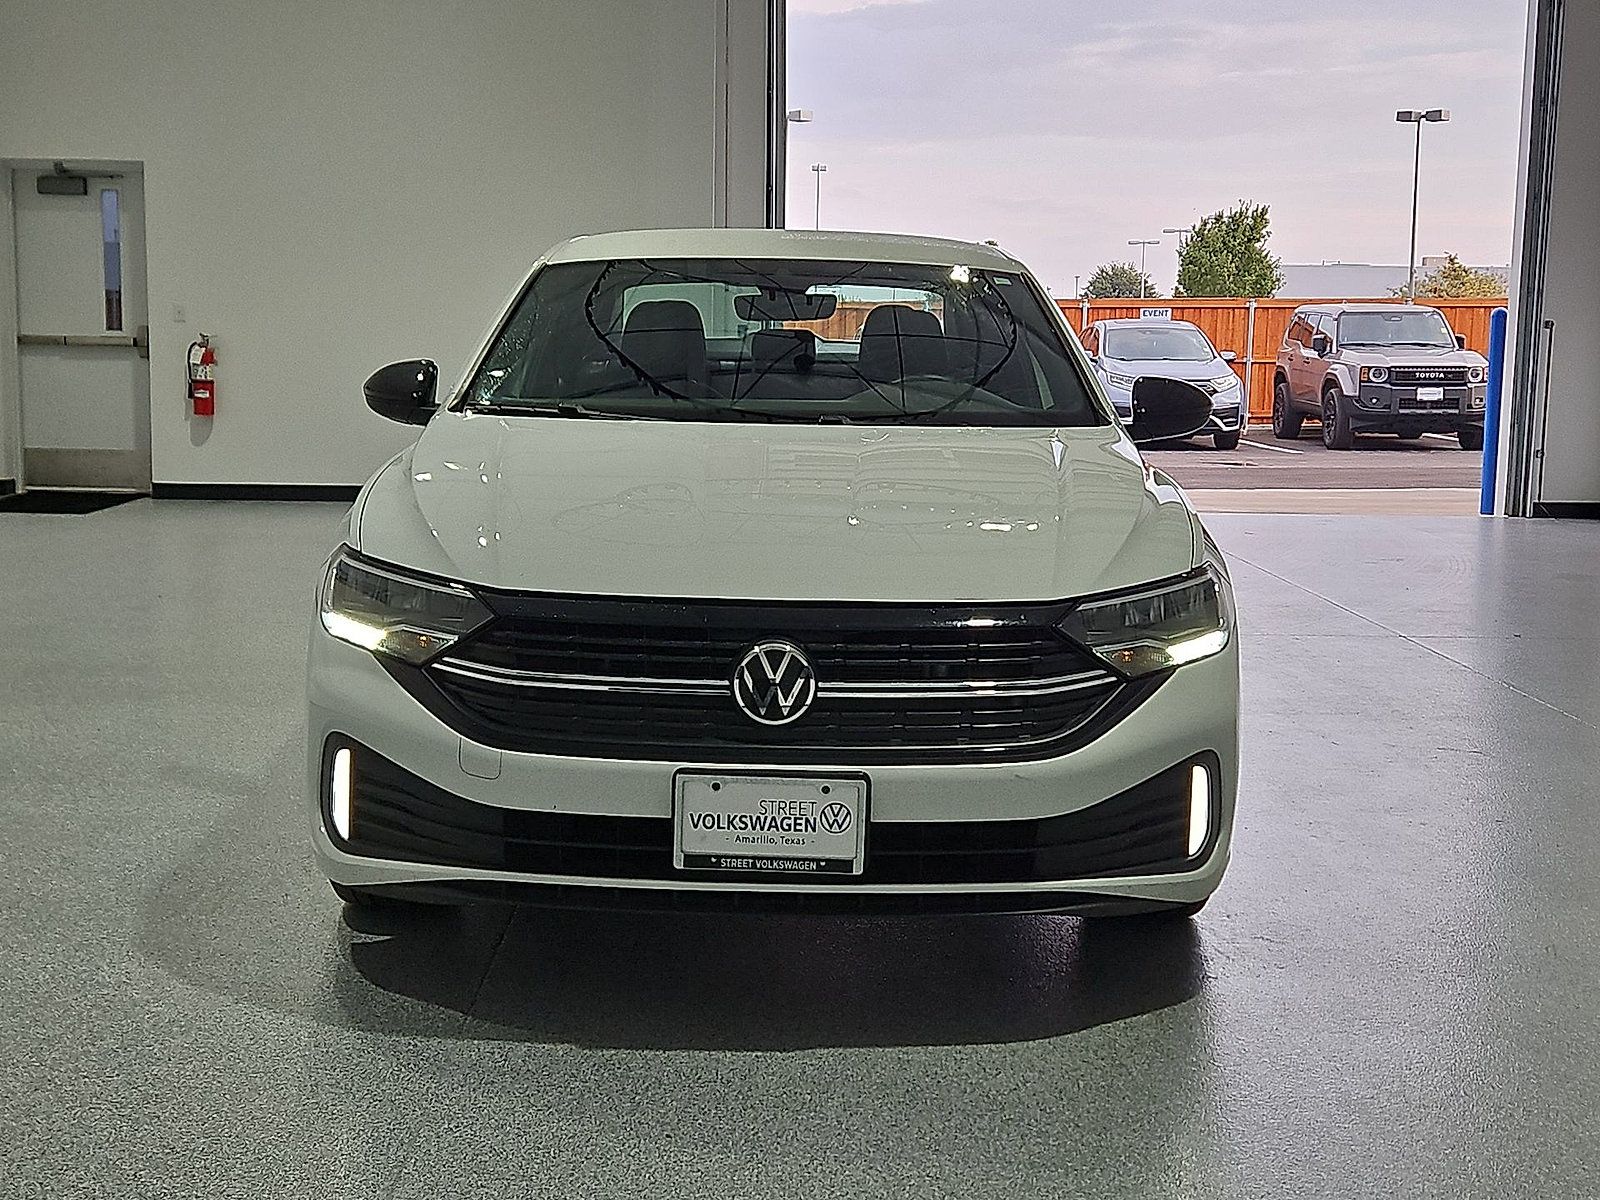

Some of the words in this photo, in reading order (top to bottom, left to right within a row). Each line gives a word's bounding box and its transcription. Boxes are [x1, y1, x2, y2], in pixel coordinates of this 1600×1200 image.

[1142, 309, 1169, 317] EVENT
[759, 800, 817, 816] STREET
[689, 812, 817, 833] VOLKSWAGEN
[734, 835, 778, 845] Amarillo,
[779, 836, 806, 845] Texas
[721, 858, 754, 868] STREET
[755, 859, 817, 870] VOLKSWAGEN
